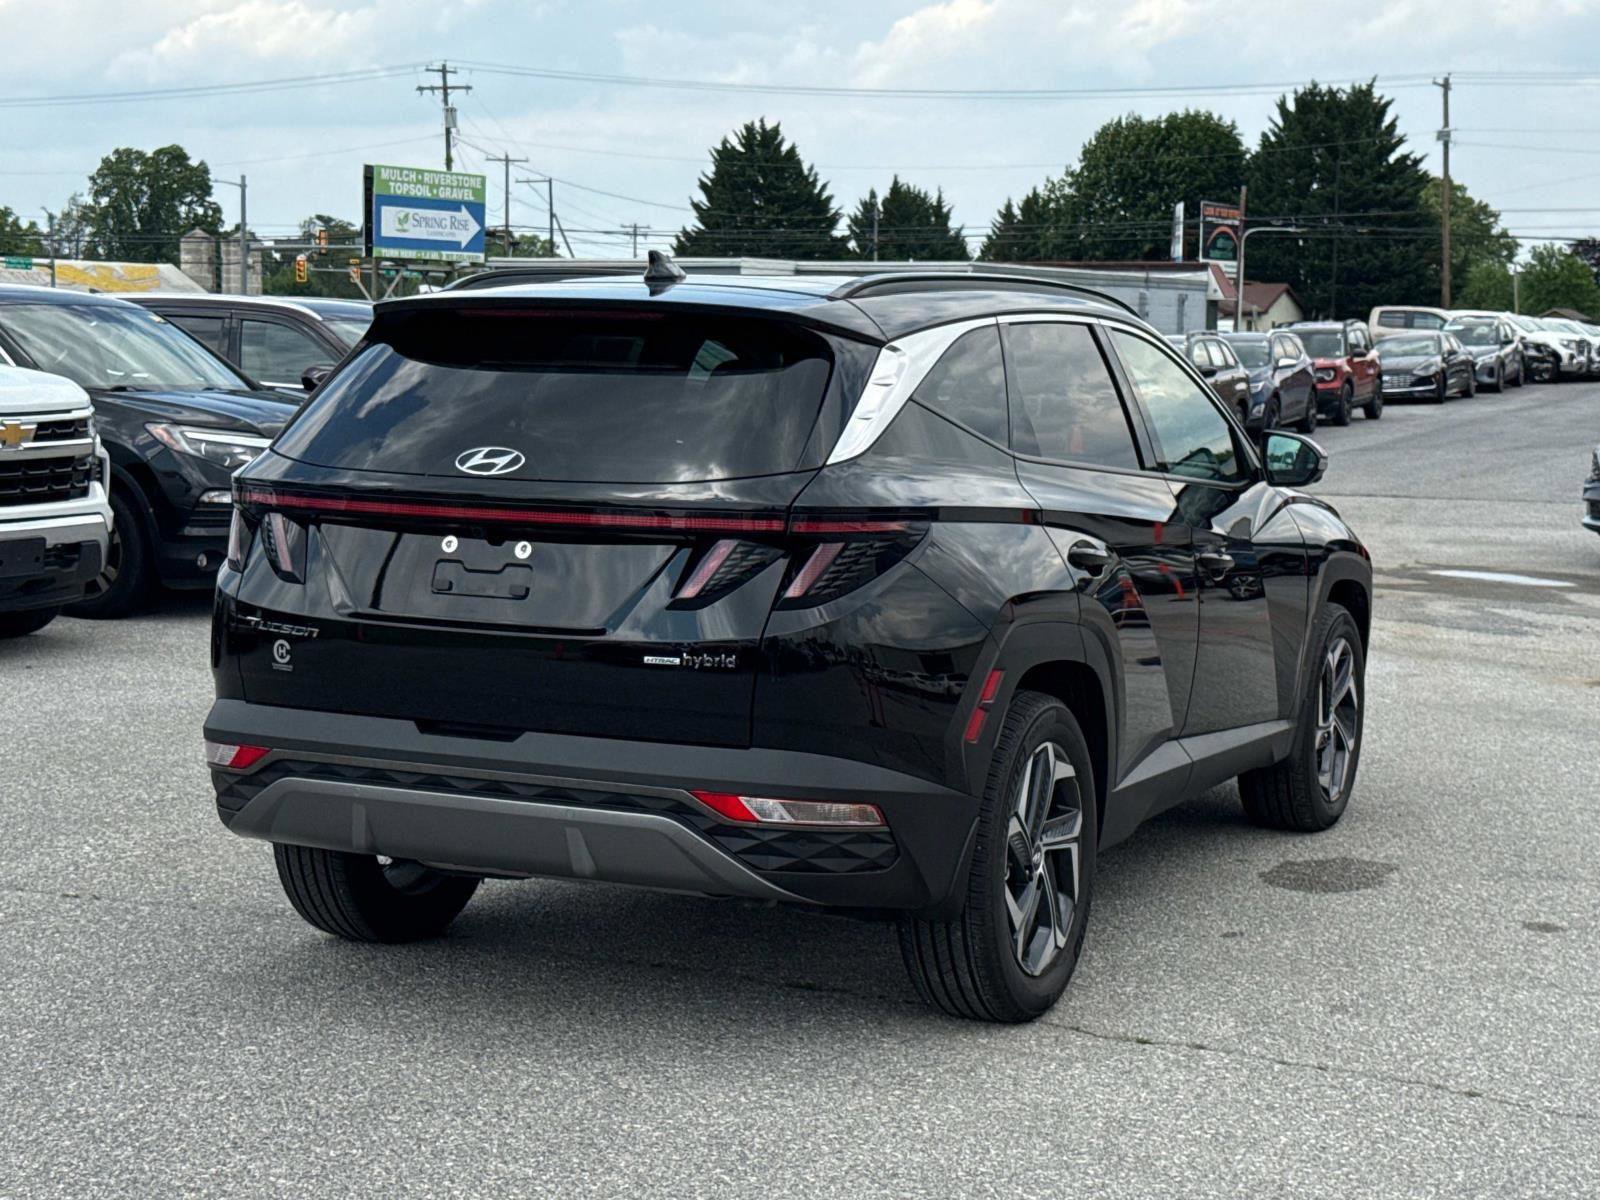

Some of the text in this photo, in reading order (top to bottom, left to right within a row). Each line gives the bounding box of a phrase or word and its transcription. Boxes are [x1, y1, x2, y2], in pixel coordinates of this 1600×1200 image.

[381, 167, 482, 189] MULCH RIVERSTONE
[388, 181, 475, 200] TOPSOIL GRAVEL
[683, 652, 736, 670] hybrid
